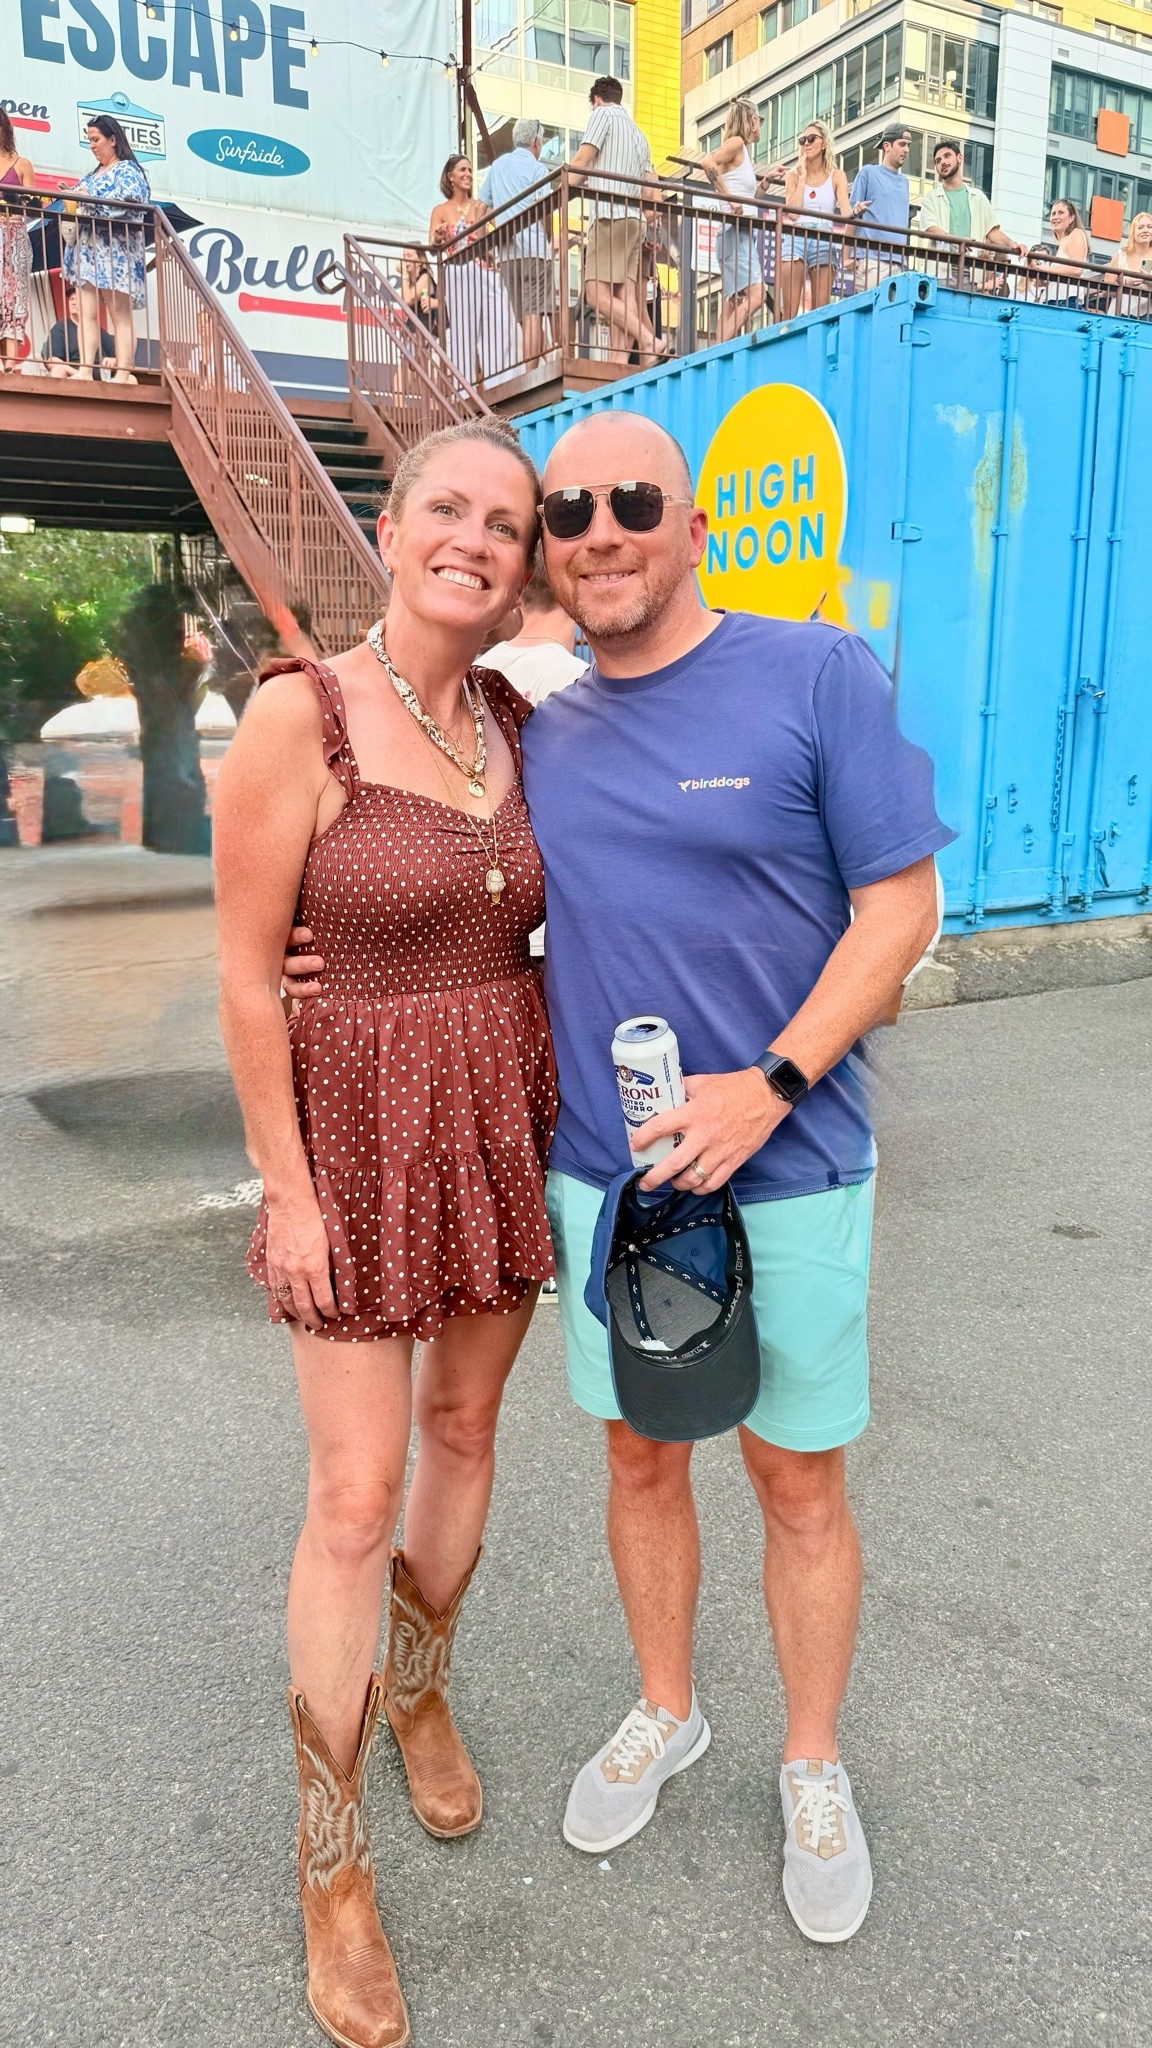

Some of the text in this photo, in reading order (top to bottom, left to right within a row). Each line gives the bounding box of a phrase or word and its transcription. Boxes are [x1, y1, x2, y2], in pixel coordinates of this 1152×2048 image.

[20, 0, 309, 110] ESCAPE
[215, 135, 285, 165] Surfside
[716, 454, 815, 519] HIGH
[707, 512, 824, 575] NOON
[691, 776, 750, 790] birddogs
[618, 1084, 660, 1100] RONI
[621, 1100, 653, 1112] ZZURRO
